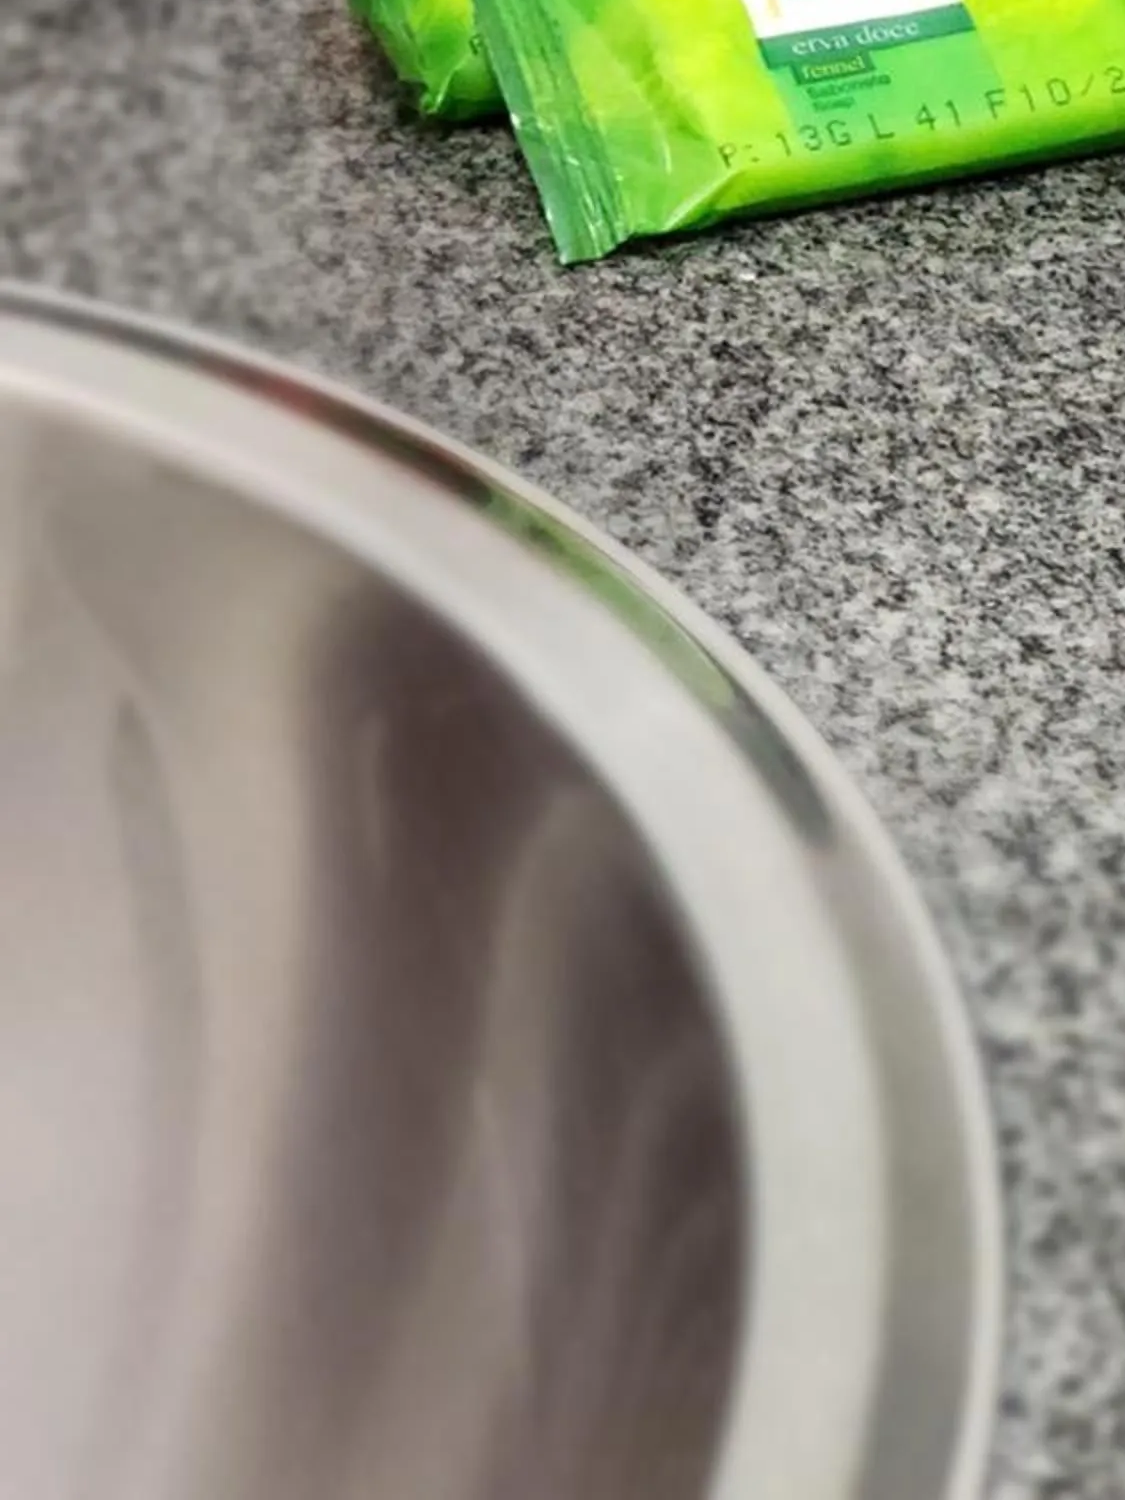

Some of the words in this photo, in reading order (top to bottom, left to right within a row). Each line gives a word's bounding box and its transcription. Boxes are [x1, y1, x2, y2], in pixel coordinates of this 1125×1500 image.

[791, 35, 851, 55] erva
[856, 22, 920, 46] doce
[801, 55, 866, 79] fennel
[868, 112, 896, 142] L
[914, 100, 962, 133] 41
